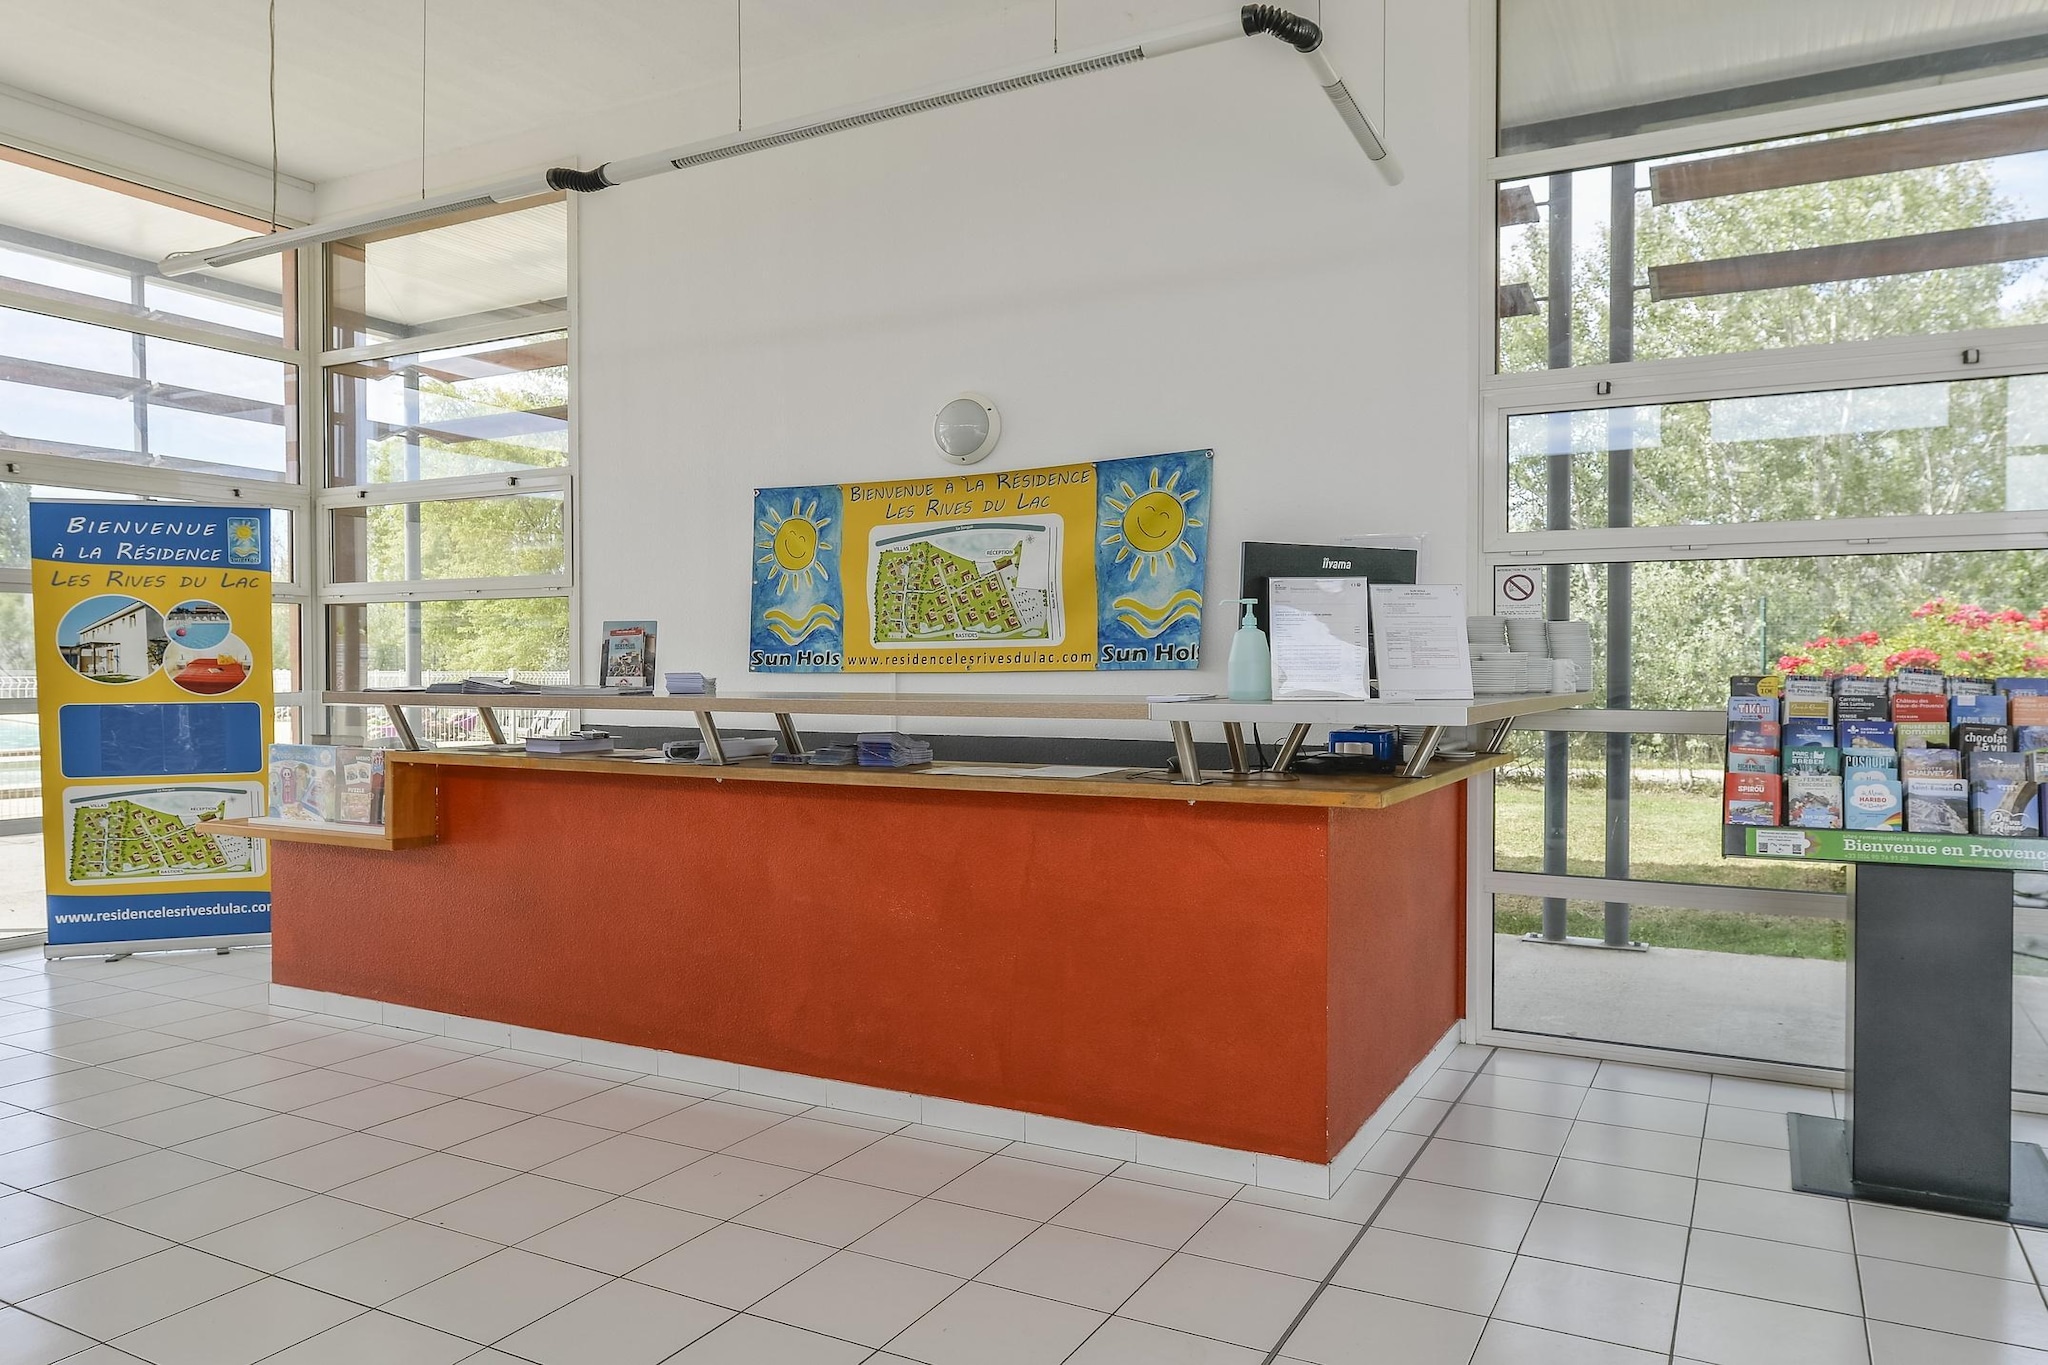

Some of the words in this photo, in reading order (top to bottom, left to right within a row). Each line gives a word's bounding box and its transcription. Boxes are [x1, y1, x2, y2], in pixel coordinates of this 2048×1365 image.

[850, 483, 934, 502] BIENVENUE
[944, 479, 954, 494] À
[966, 478, 984, 493] LA
[997, 469, 1091, 490] RÉSIDENCE
[885, 503, 915, 520] LES
[925, 499, 973, 517] RIVES
[983, 499, 1006, 513] DU
[1017, 492, 1051, 510] LAC
[66, 516, 217, 537] BIENVENUE
[51, 542, 65, 559] À
[78, 546, 102, 560] LA
[116, 542, 222, 562] RÉSIDENCE
[1322, 557, 1352, 570] iiyama
[51, 570, 92, 587] LES
[106, 570, 166, 588] RIVES
[179, 576, 207, 588] DU
[220, 572, 260, 589] LAC
[750, 650, 791, 667] Sun
[796, 650, 841, 667] Hols
[848, 651, 1092, 666] www.residencelesrivesdulac.com
[1101, 645, 1148, 663] Sun
[1965, 732, 2007, 744] chocolat
[1982, 743, 1990, 752] &
[1991, 743, 2007, 752] vin
[1843, 839, 1938, 855] Bienvenue
[1942, 845, 1964, 856] en
[1969, 844, 2048, 860] Provenc
